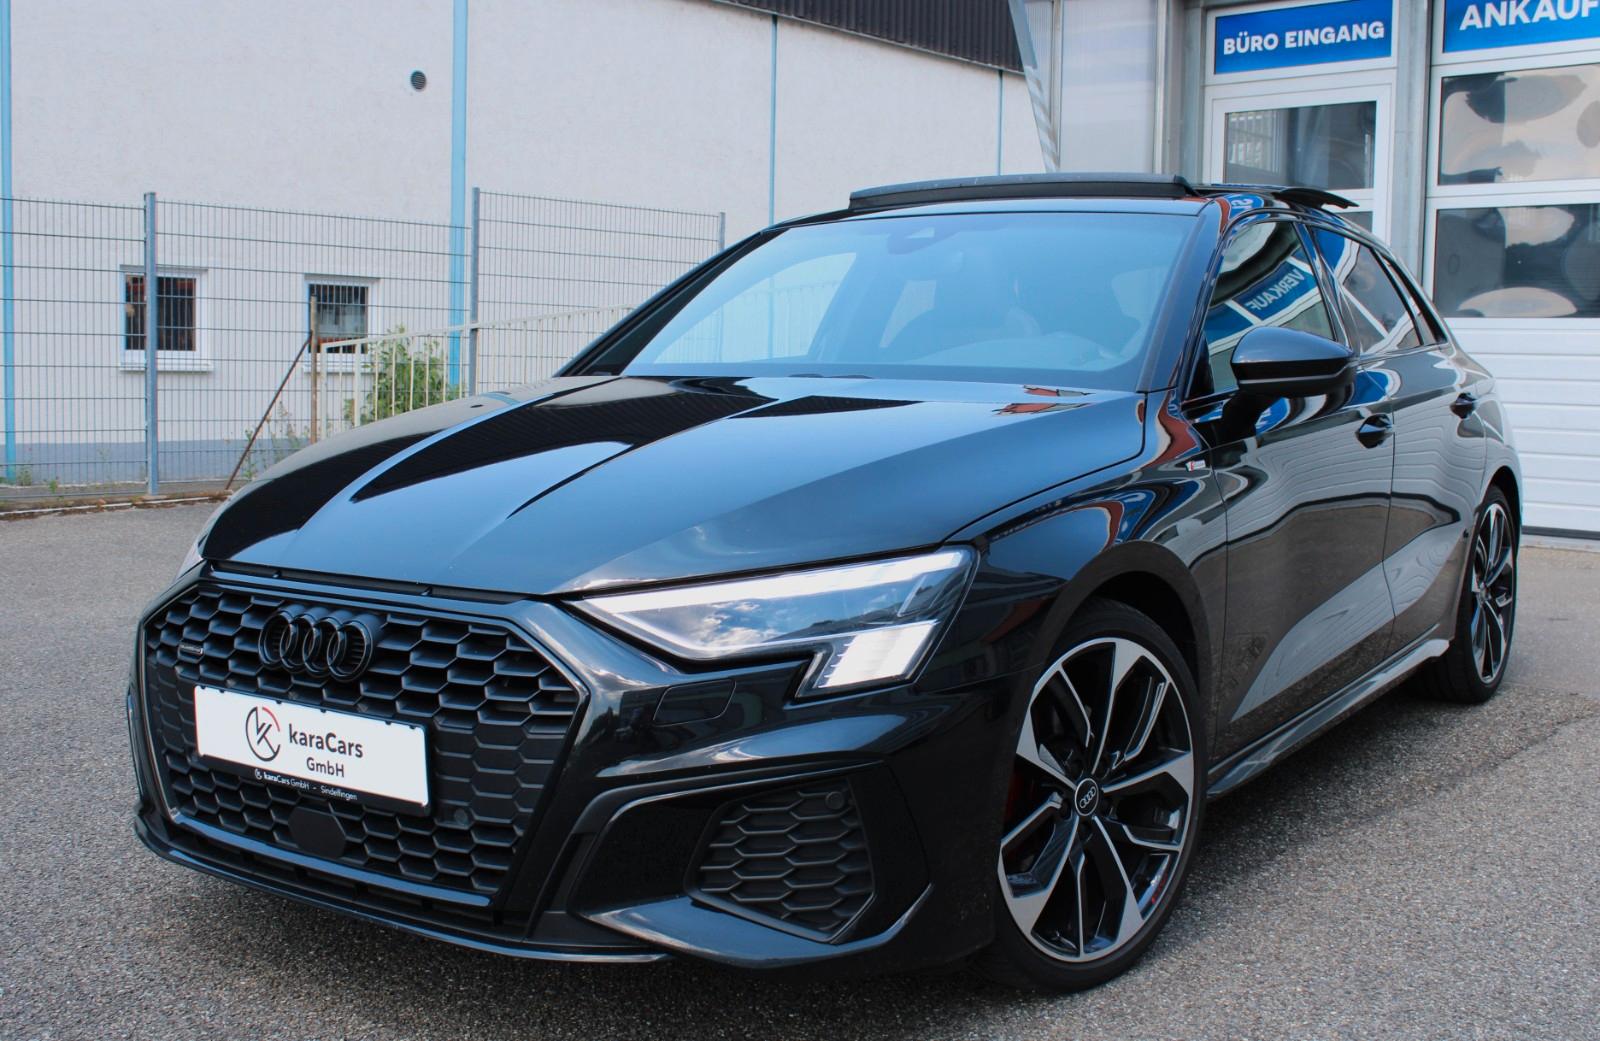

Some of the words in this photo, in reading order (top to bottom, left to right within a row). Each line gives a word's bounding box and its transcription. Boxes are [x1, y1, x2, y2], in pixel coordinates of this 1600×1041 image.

[1459, 0, 1599, 31] ANKAUF
[1223, 31, 1279, 55] BÜRO
[1285, 21, 1385, 49] EINGANG
[288, 723, 364, 759] karaCars
[306, 757, 345, 778] GmbH
